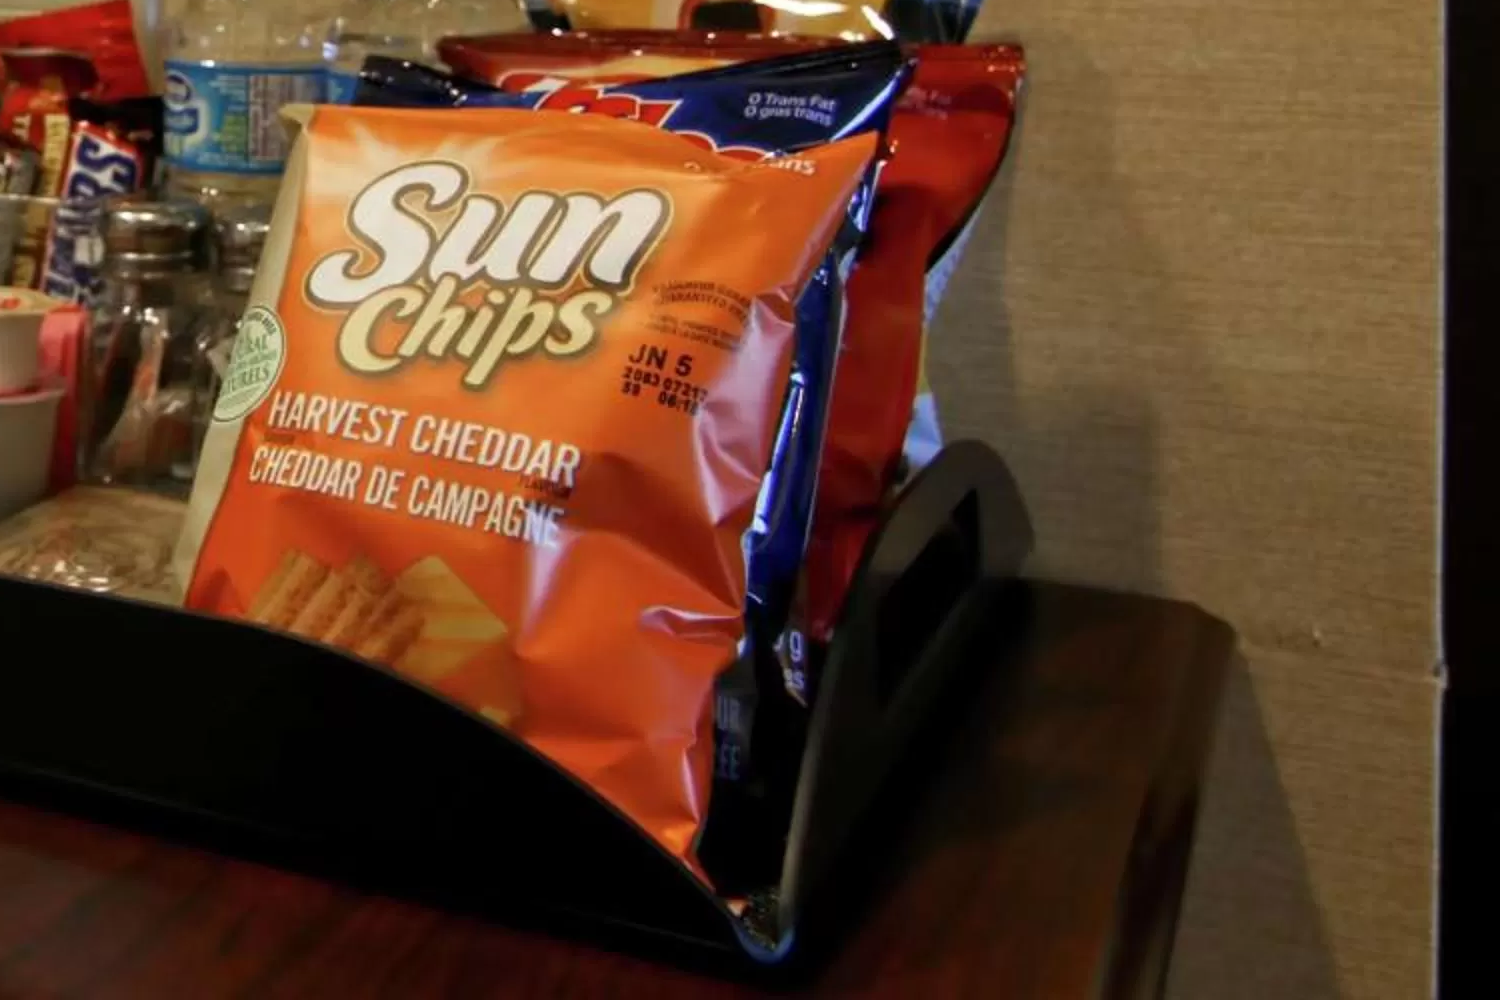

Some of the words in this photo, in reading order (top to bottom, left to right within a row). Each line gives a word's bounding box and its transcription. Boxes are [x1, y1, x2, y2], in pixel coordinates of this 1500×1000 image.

[764, 92, 807, 107] Trans
[810, 94, 837, 112] Fat
[794, 107, 832, 127] trans
[306, 160, 670, 308] Sun
[337, 284, 618, 391] Chips
[628, 343, 669, 380] JN
[673, 353, 694, 378] 5
[267, 391, 408, 448] HARVEST
[410, 414, 581, 489] CHEDDAR
[249, 444, 362, 500] CHEDDAR
[364, 466, 405, 510] DE
[407, 474, 565, 549] CAMPAGNE
